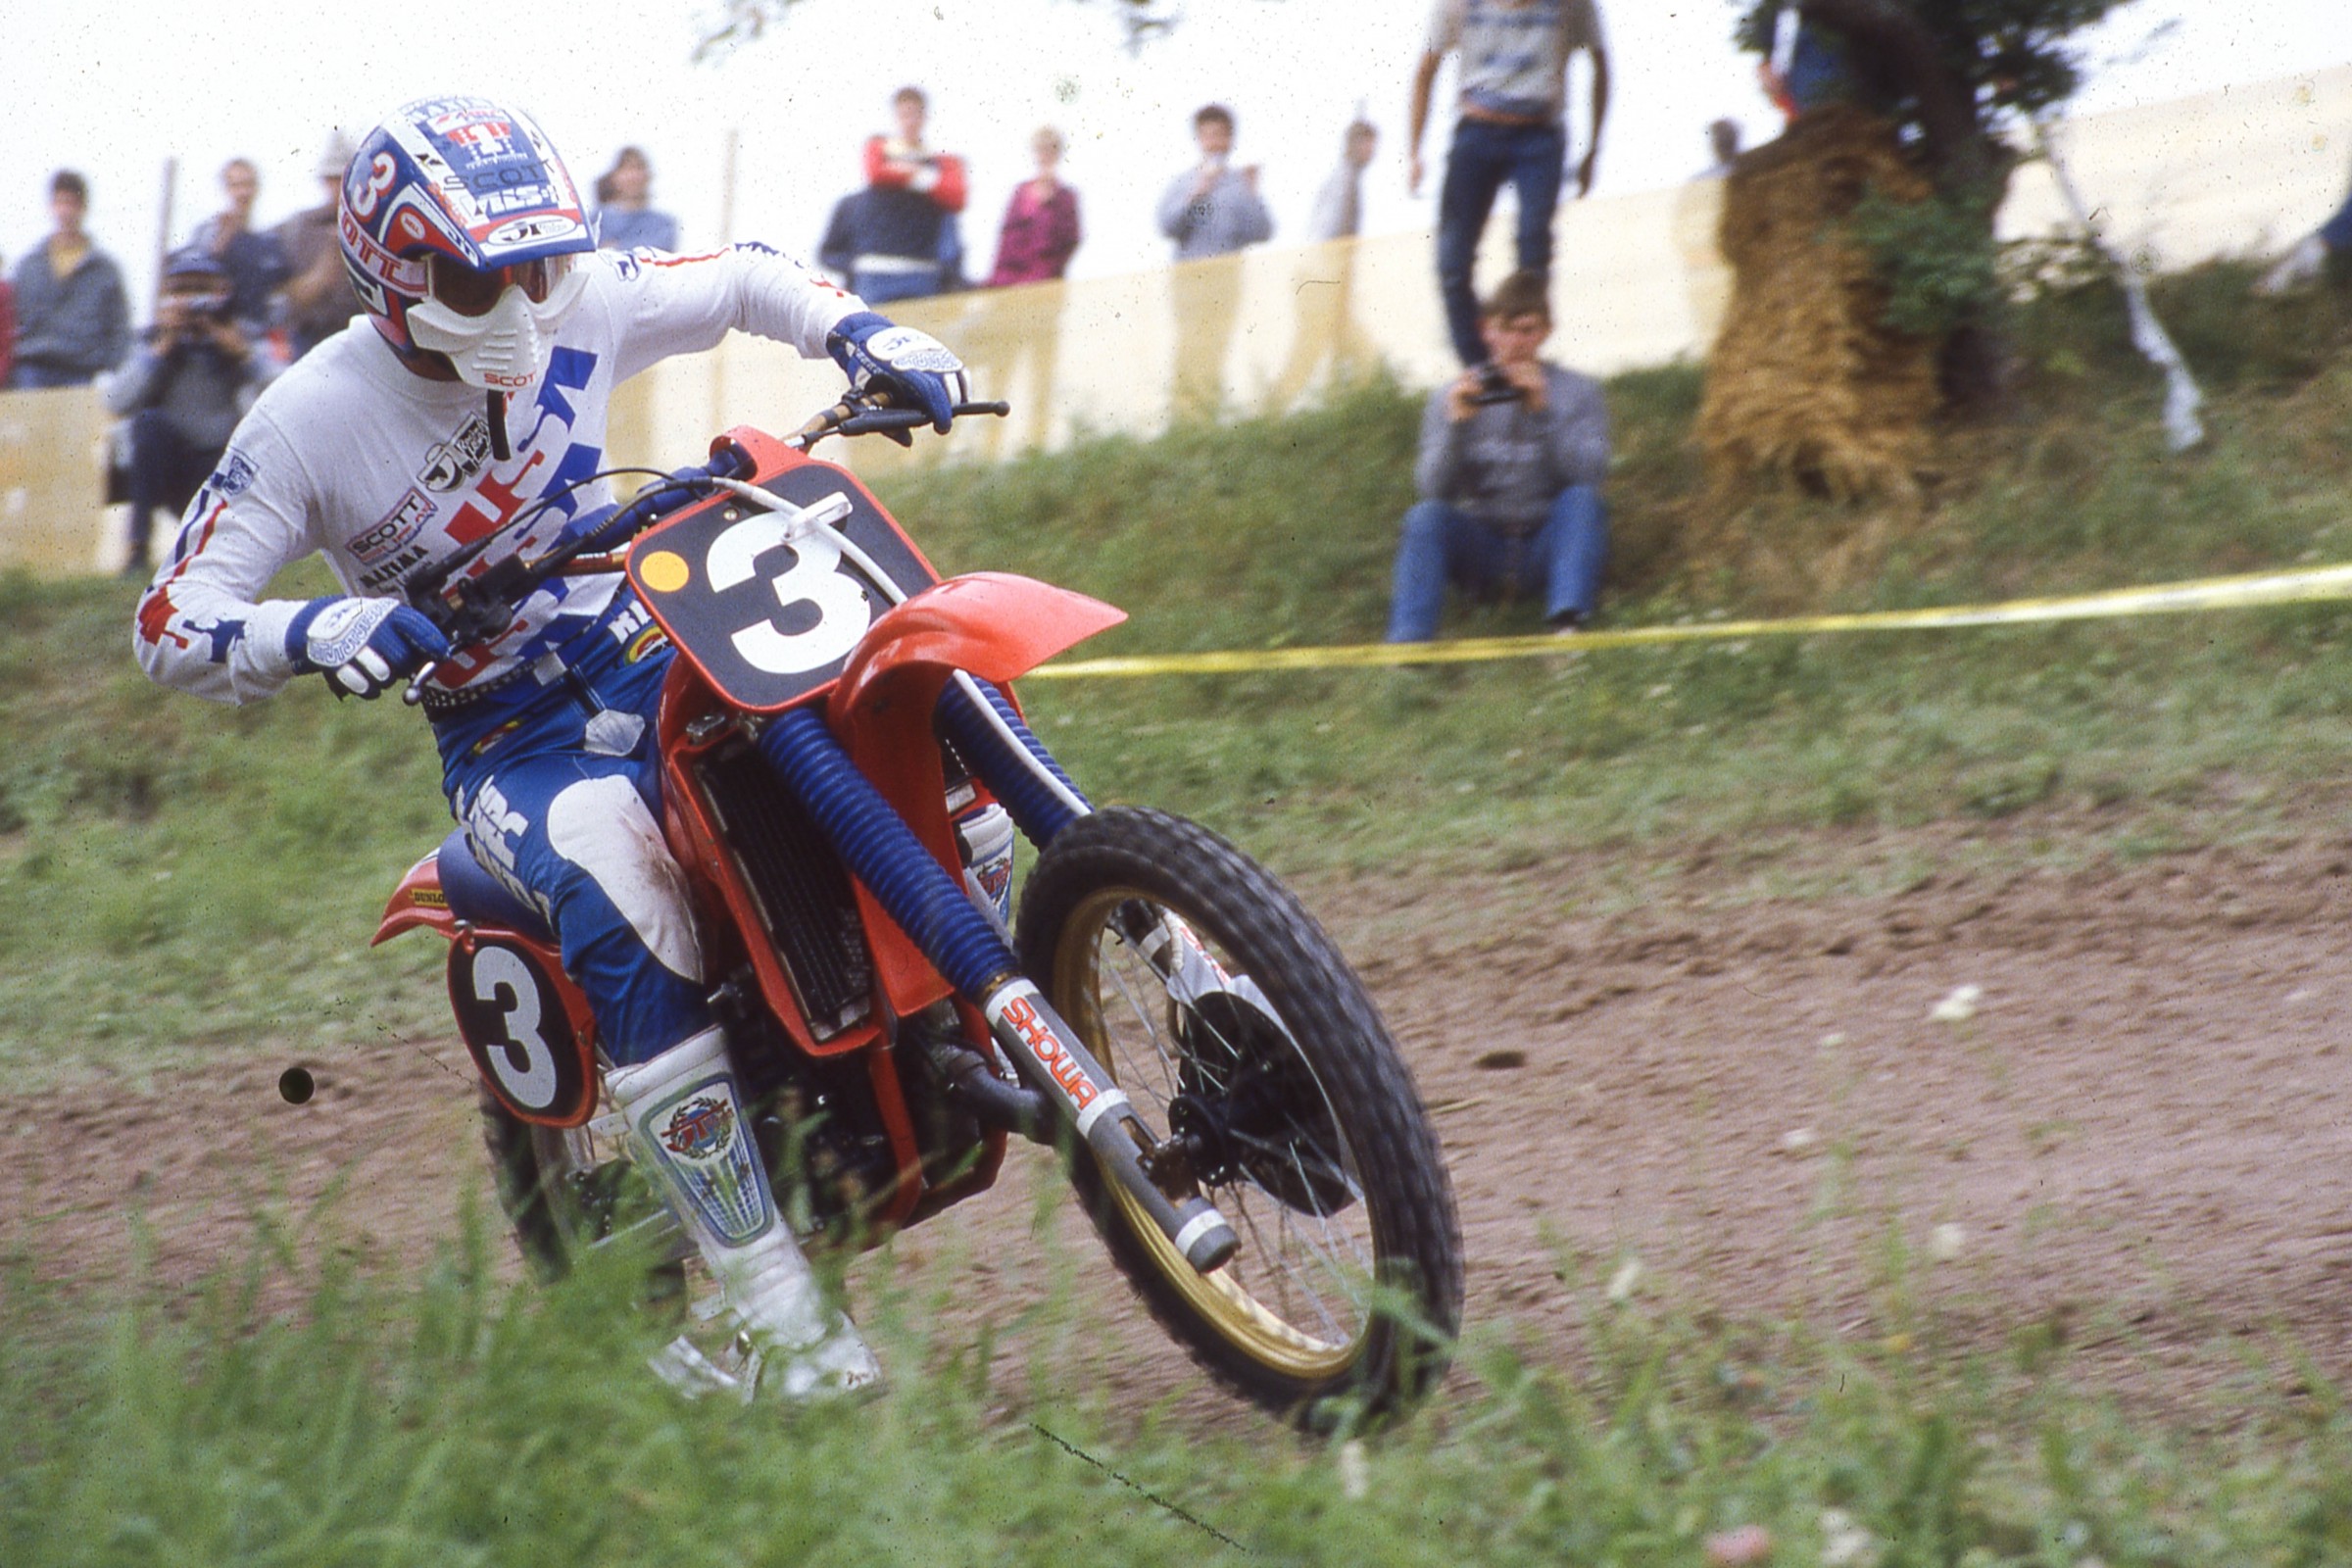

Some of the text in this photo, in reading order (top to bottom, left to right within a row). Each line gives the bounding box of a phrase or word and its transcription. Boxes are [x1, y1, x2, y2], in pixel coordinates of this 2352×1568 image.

[352, 151, 398, 224] 3
[443, 158, 555, 191] SCOTT
[353, 495, 420, 554] SCOTT
[359, 544, 429, 589] MAXIMA
[707, 510, 872, 674] 3
[414, 891, 446, 904] DUNLO
[471, 945, 558, 1109] 3
[1001, 995, 1099, 1111] SHOWA
